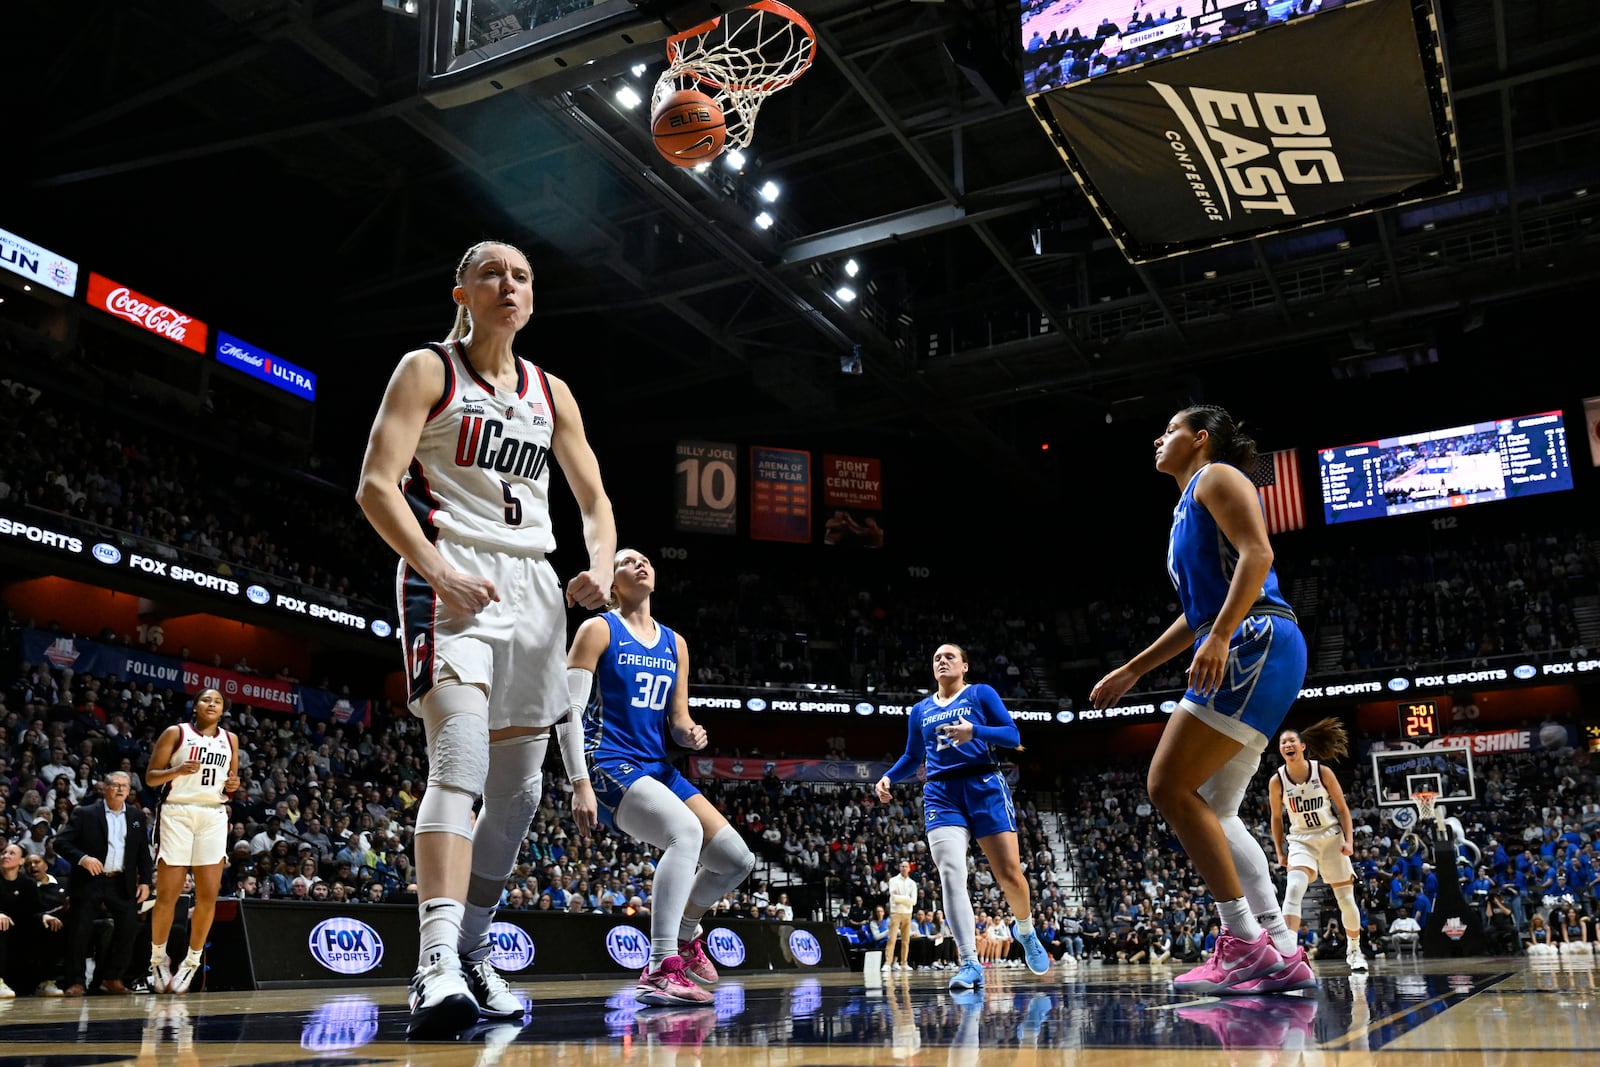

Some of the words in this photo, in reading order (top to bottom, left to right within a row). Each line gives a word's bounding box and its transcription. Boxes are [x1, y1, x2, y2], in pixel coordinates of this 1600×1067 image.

[1244, 1, 1257, 12] 42
[1255, 92, 1344, 186] BIG
[1188, 87, 1296, 216] EAST
[1165, 129, 1224, 222] CONFERENCE
[220, 342, 263, 368] Michelob
[272, 364, 313, 391] ULTRA
[676, 446, 704, 456] BILLY
[708, 449, 735, 460] JOEL
[758, 461, 789, 471] ARENA
[791, 464, 803, 472] OF
[835, 460, 870, 472] FIGHT
[676, 458, 736, 510] 10
[760, 470, 776, 479] THE
[779, 472, 802, 481] YEAR
[826, 477, 880, 491] CENTURY
[500, 480, 522, 526] 5
[1432, 516, 1458, 530] 112
[660, 547, 687, 559] 109
[0, 518, 82, 553] SPORTS
[130, 554, 167, 576] FOX
[170, 566, 239, 595] SPORTS
[276, 595, 306, 613] FOX
[309, 604, 366, 629] SPORTS
[908, 566, 930, 578] 110
[137, 624, 164, 646] 16
[618, 653, 676, 673] CREIGHTON
[125, 659, 178, 681] FOLLOW
[182, 671, 199, 686] US
[203, 676, 220, 690] ON
[242, 684, 299, 705] @BIGEAST
[1297, 688, 1323, 699] FOX
[1326, 682, 1382, 696] SPORTS
[1415, 676, 1444, 687] FOX
[1447, 670, 1507, 684] SPORTS
[1543, 663, 1574, 675] FOX
[630, 672, 672, 710] 30
[688, 698, 741, 708] SPORTS
[772, 701, 797, 711] FOX
[800, 703, 850, 713] SPORTS
[879, 706, 903, 715] FOX
[1079, 710, 1102, 720] FOX
[1105, 704, 1155, 717] SPORTS
[1409, 705, 1434, 716] 7:01
[1452, 705, 1480, 720] 20
[922, 707, 972, 727] CREIGHTON
[1406, 716, 1433, 736] 24
[1474, 731, 1531, 752] SHINE
[189, 746, 227, 768] UConn
[201, 768, 216, 786] 21
[1289, 796, 1323, 813] UConn
[1304, 812, 1321, 828] 20
[325, 929, 368, 952] FOX
[489, 933, 522, 951] FOX
[614, 935, 642, 952] FOX
[714, 936, 736, 952] FOX
[795, 937, 813, 951] FOX
[329, 953, 370, 961] SPORTS
